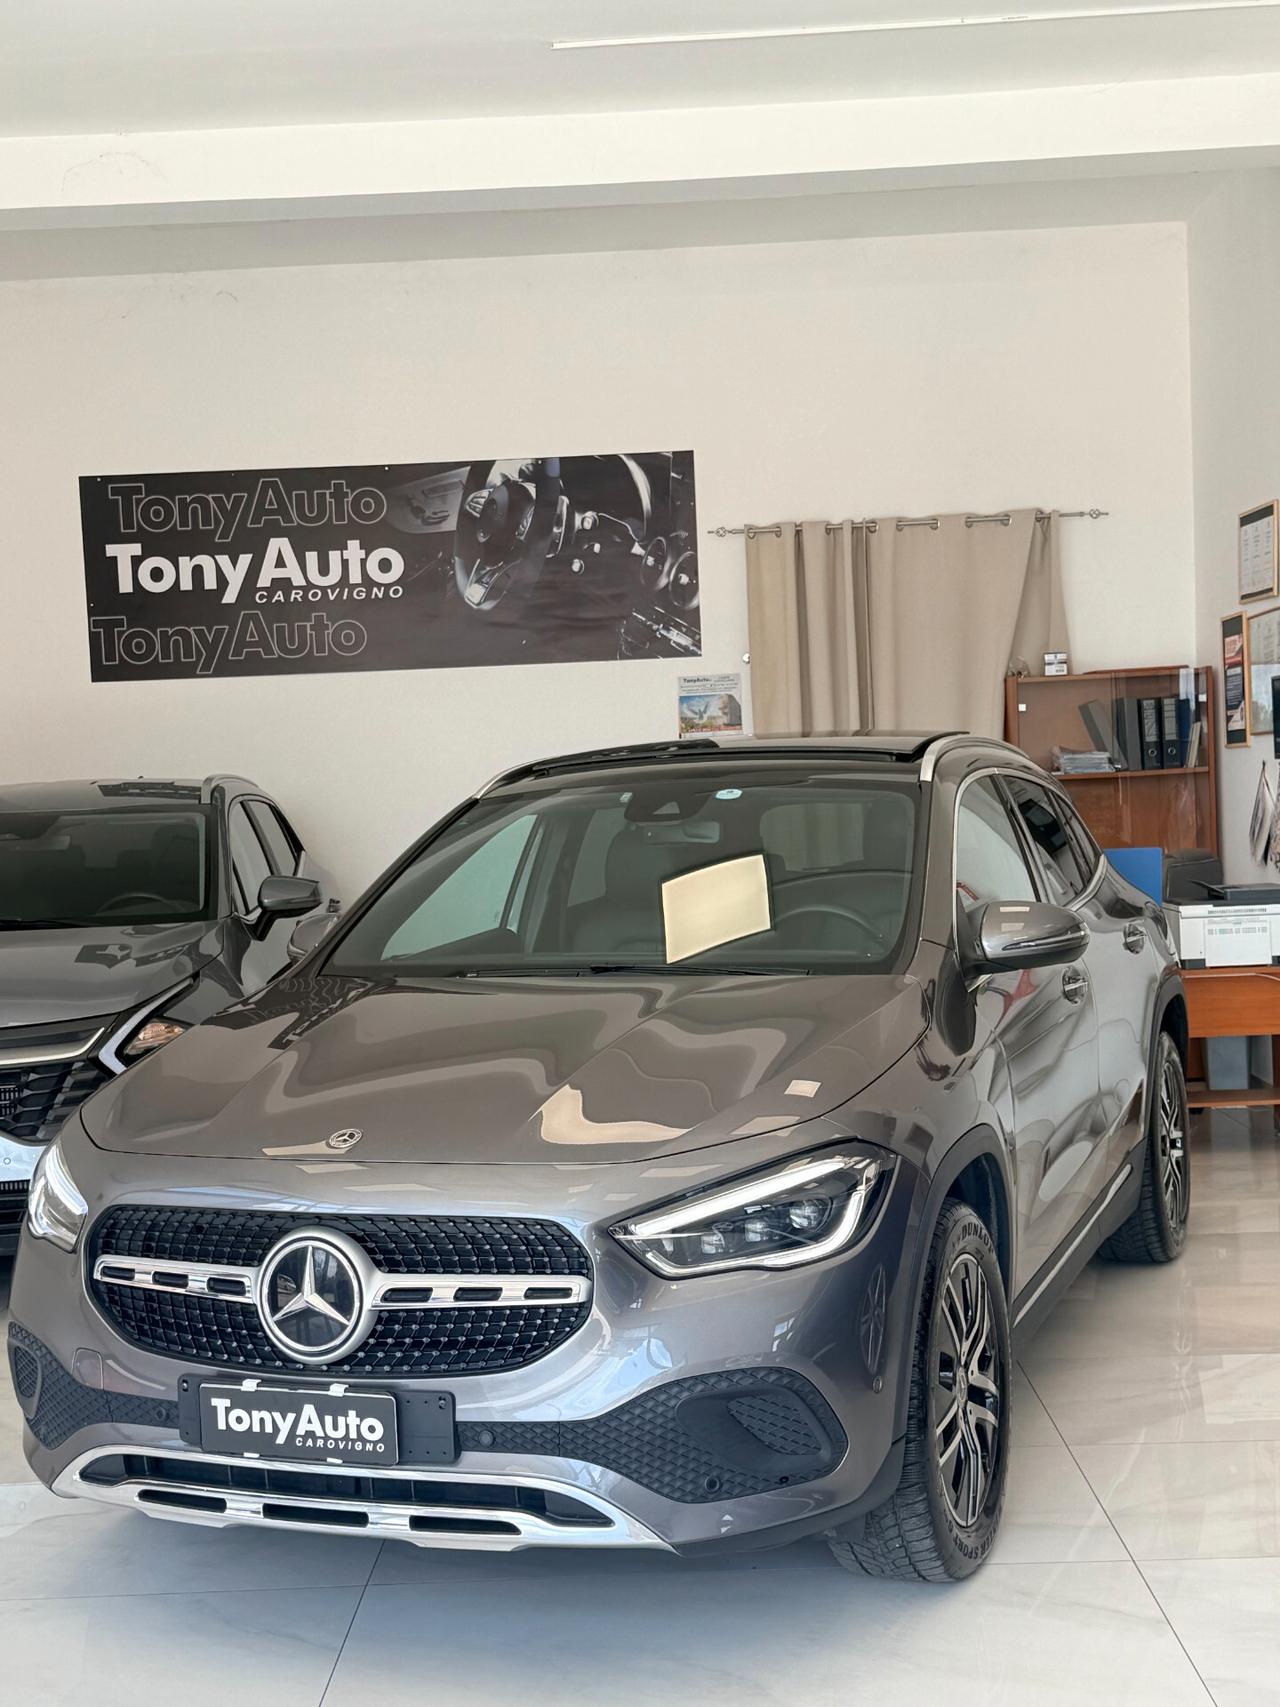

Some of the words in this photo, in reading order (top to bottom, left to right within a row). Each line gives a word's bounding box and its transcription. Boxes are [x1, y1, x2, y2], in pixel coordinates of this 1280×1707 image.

[105, 539, 405, 604] TonyAuto
[255, 587, 404, 603] CAROVIGNO
[211, 1398, 384, 1444] TonyAuto
[295, 1437, 385, 1453] CAROVIGNO
[953, 1533, 979, 1559] SPORT
